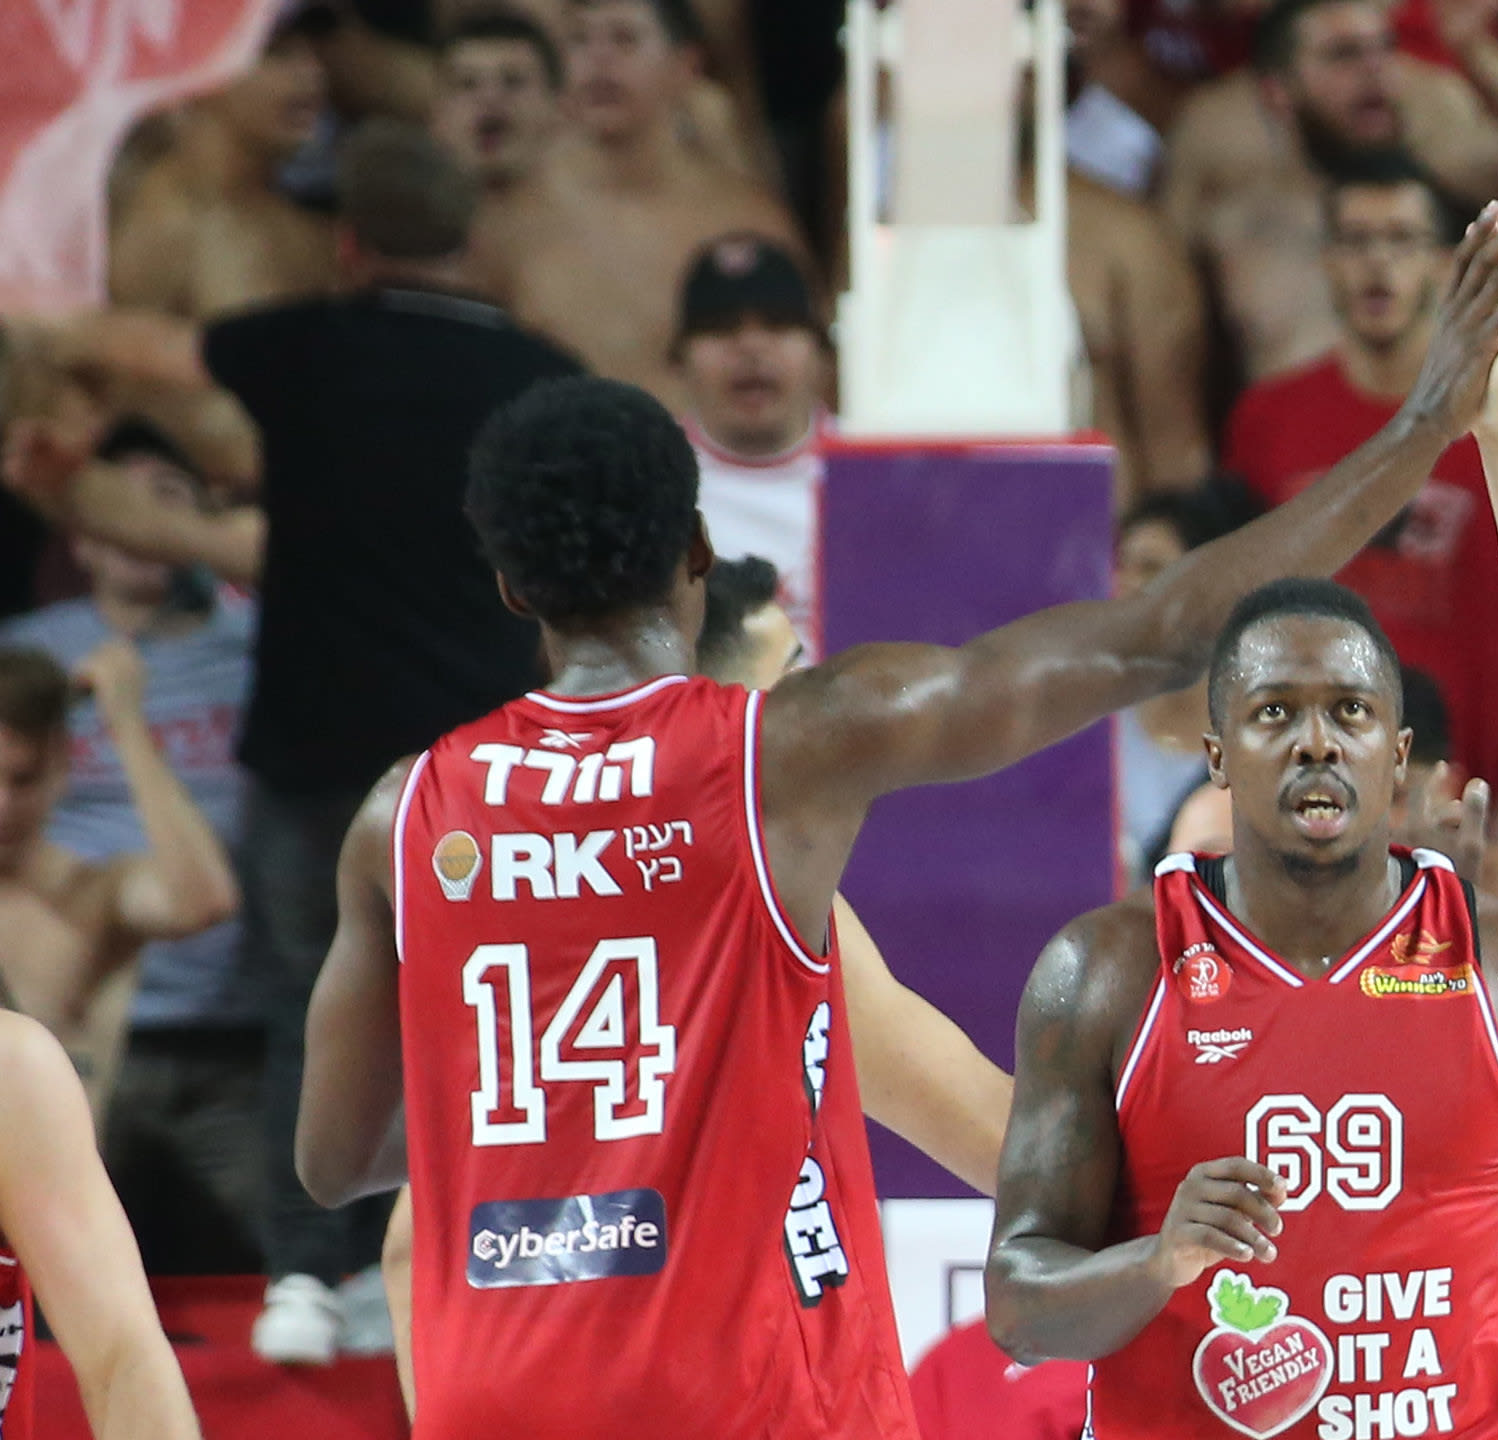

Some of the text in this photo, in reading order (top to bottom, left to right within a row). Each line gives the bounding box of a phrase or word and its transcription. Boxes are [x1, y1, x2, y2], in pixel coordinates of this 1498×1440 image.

[470, 736, 656, 806] הורד
[491, 830, 623, 899] RK
[623, 820, 693, 859] רענן
[637, 856, 683, 891] כץ
[1375, 975, 1447, 994] Winner
[462, 937, 676, 1147] 14
[1187, 1027, 1253, 1045] Reebok
[1245, 1094, 1403, 1211] 69
[473, 1215, 660, 1269] CyberSafe
[1323, 1267, 1452, 1323] GIVE
[1218, 1347, 1320, 1412] FRIENDLY
[1223, 1332, 1304, 1381] VEGAN
[1337, 1328, 1441, 1382] IT A
